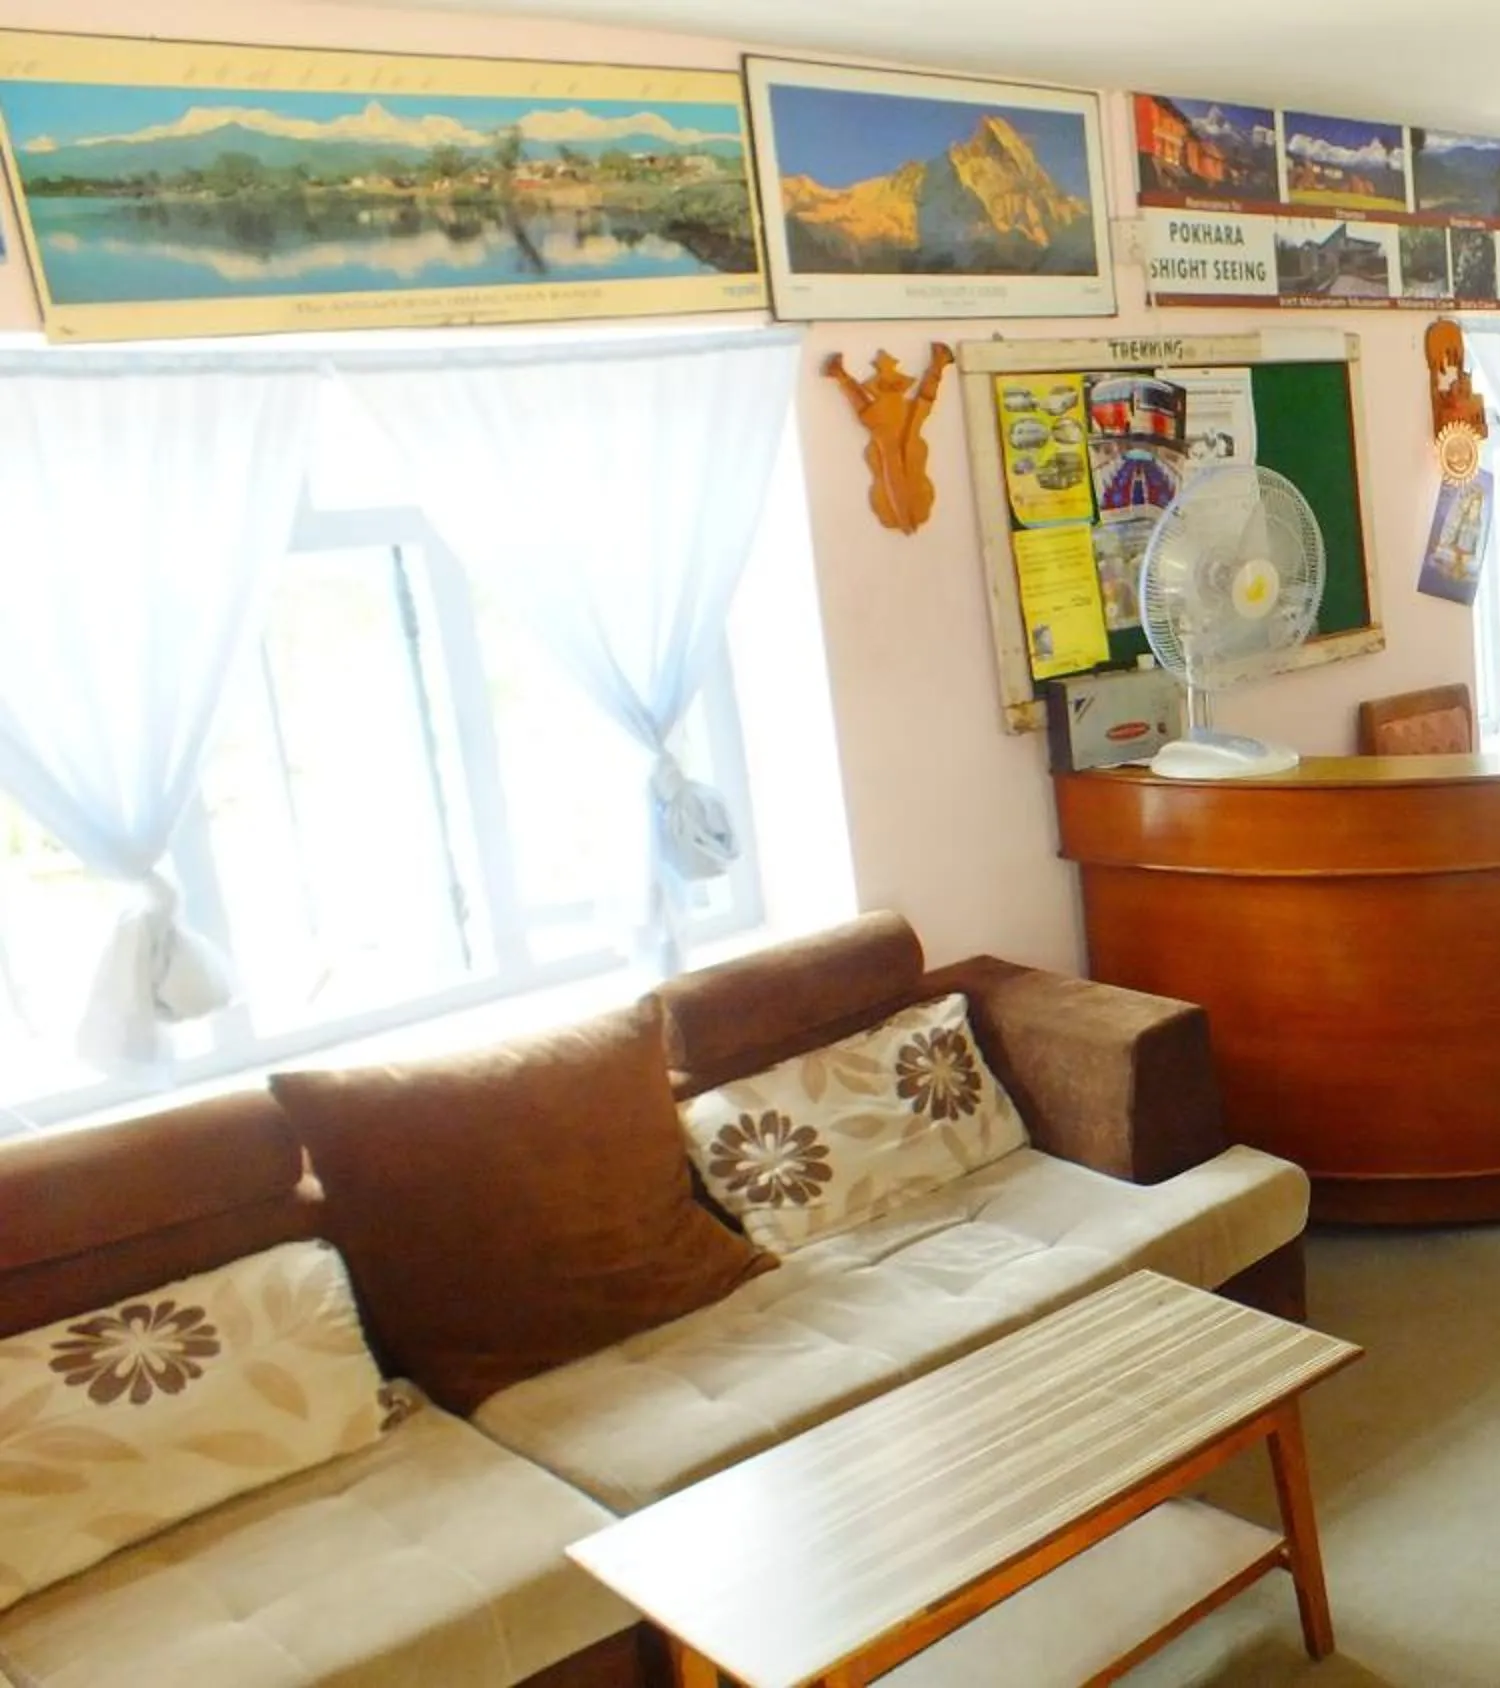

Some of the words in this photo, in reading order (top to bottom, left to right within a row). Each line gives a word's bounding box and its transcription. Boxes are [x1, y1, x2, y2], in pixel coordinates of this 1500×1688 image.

[1169, 221, 1244, 247] POKHARA
[1151, 257, 1208, 280] SHIGHT
[1213, 258, 1267, 282] SEEING
[1107, 338, 1183, 361] TREKKING
